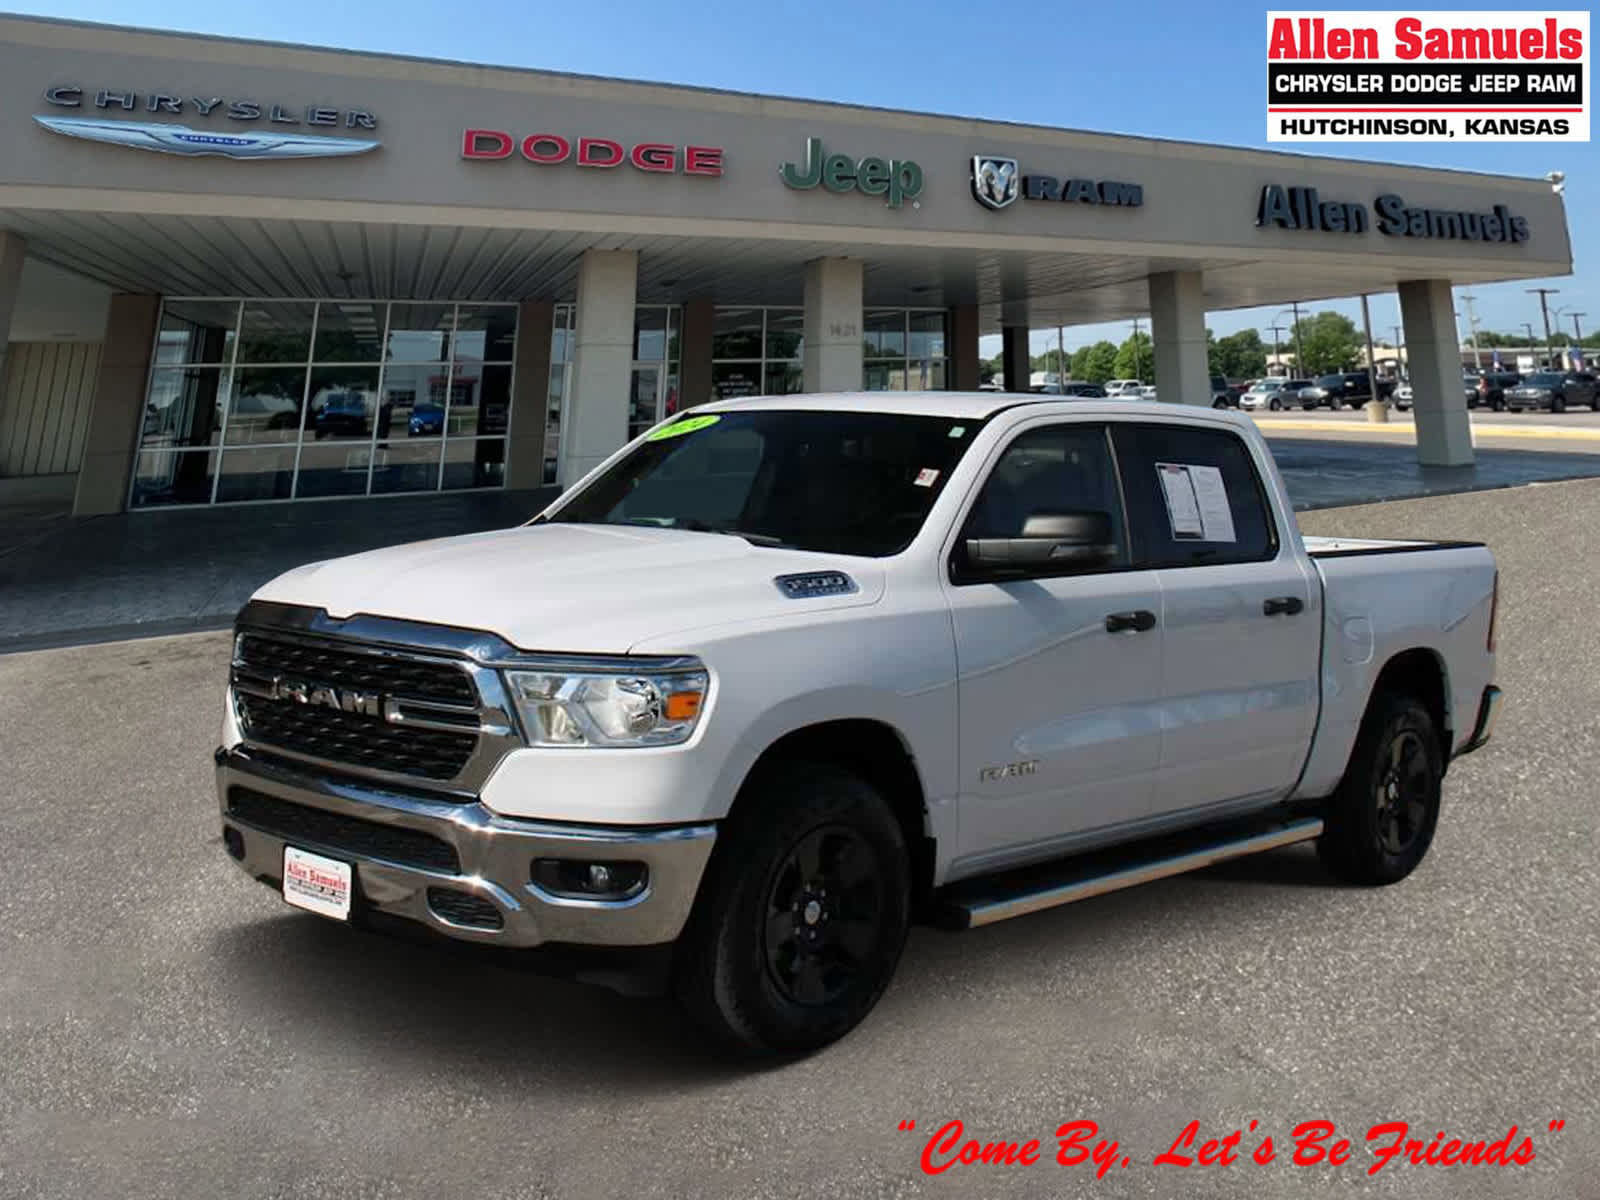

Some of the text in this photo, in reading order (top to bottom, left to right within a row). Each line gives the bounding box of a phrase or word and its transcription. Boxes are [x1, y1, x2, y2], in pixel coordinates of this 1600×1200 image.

[43, 86, 378, 129] CHRYSLER
[461, 127, 724, 177] DODGE
[779, 136, 924, 209] Jeep
[1022, 174, 1144, 207] RAM
[1255, 184, 1530, 243] Allen Samuels
